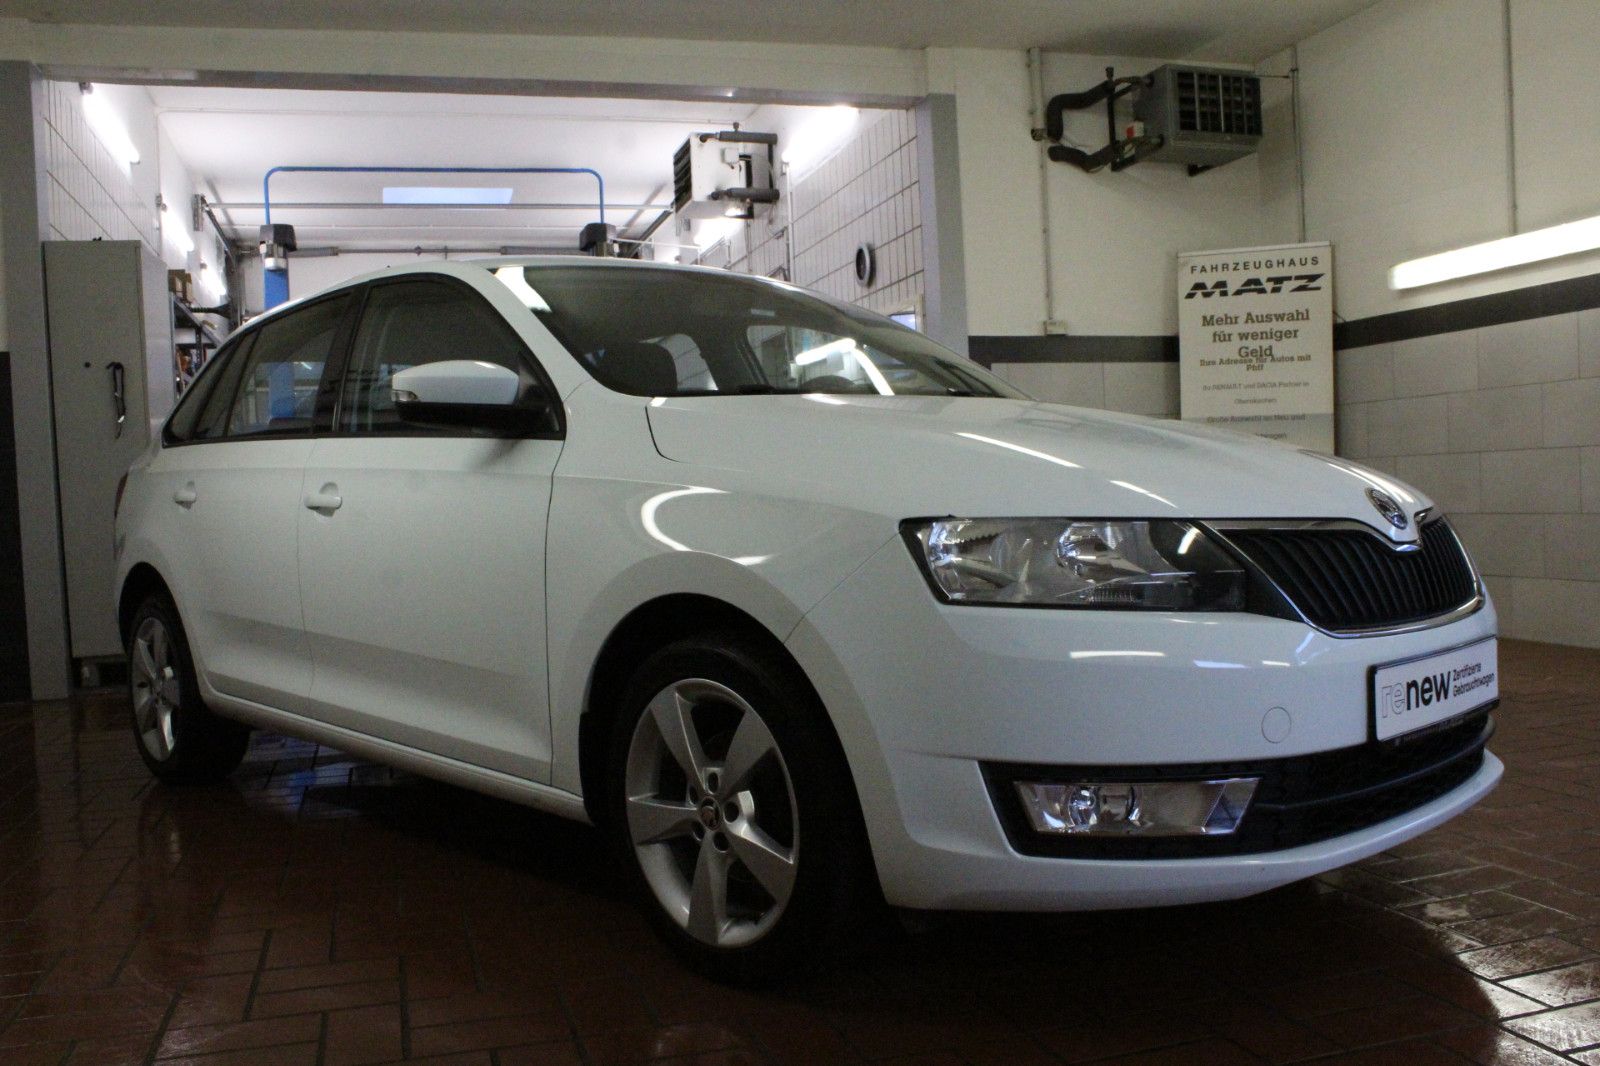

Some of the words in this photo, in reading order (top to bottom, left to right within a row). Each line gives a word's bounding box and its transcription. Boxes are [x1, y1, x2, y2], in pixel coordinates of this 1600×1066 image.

[1190, 256, 1320, 274] FAHRZEUGHAUS
[1184, 273, 1325, 299] MATZ
[1201, 313, 1240, 327] Mehr
[1244, 309, 1310, 324] Auswahl
[1212, 331, 1235, 343] für
[1238, 328, 1299, 342] weniger
[1238, 345, 1273, 358] Geld
[1270, 354, 1295, 362] Autos
